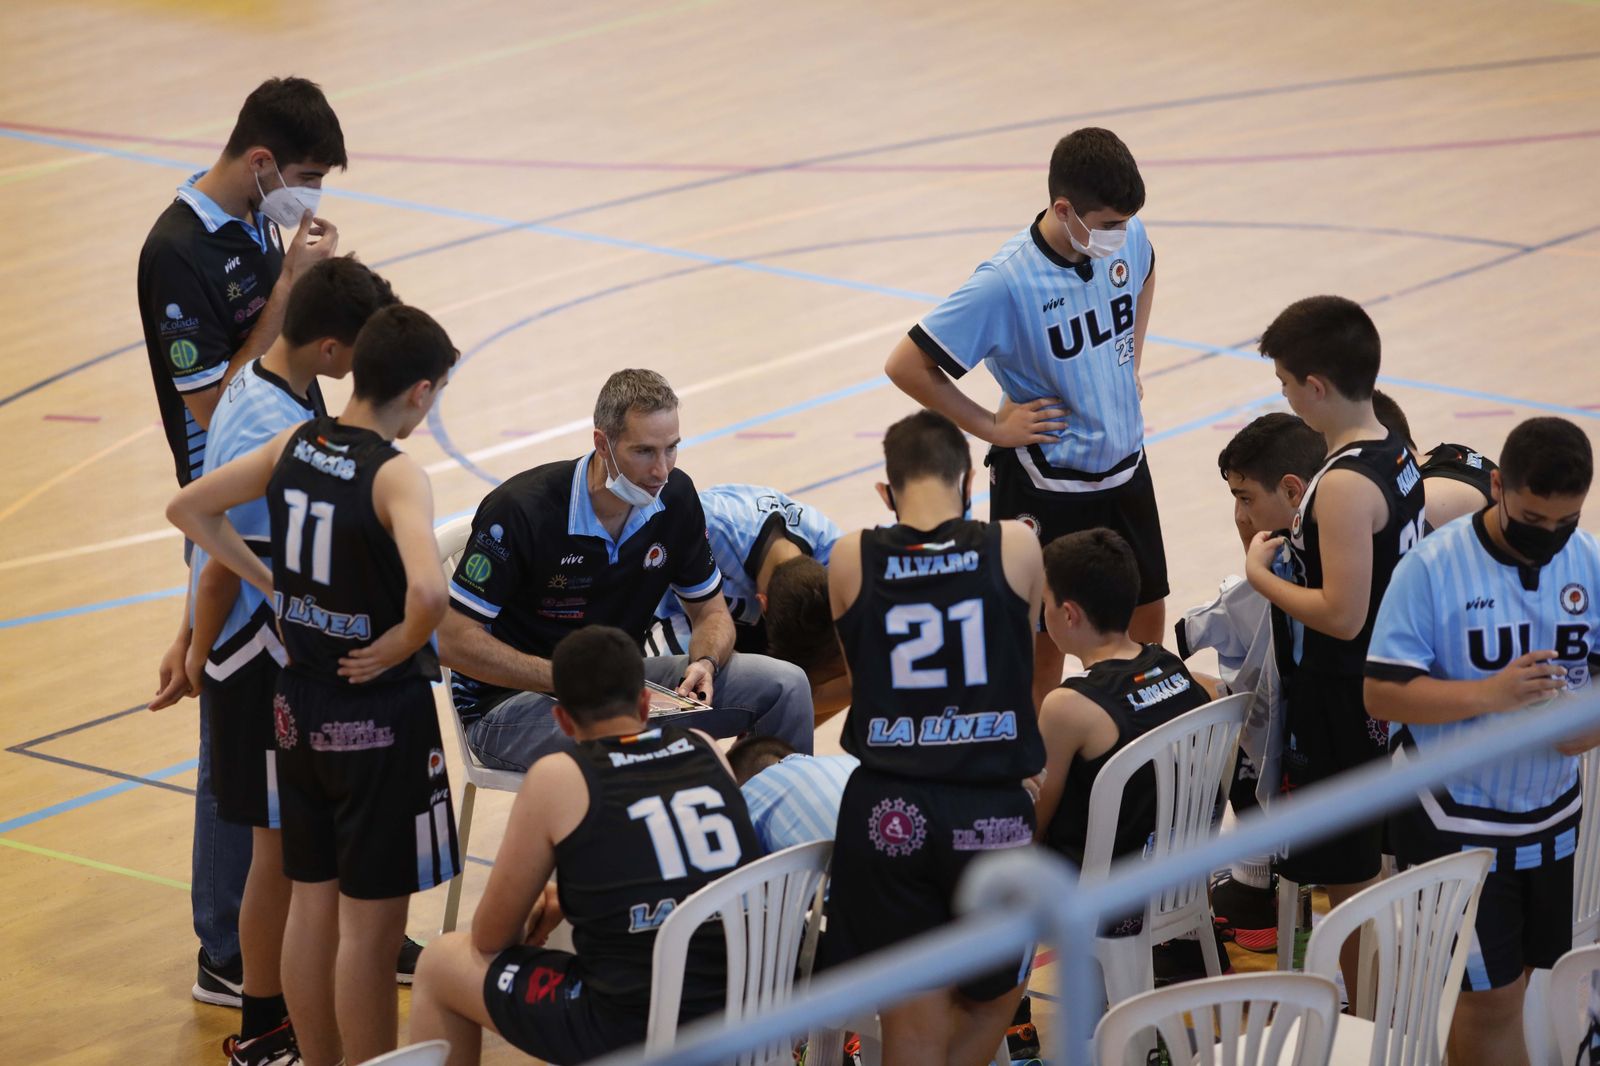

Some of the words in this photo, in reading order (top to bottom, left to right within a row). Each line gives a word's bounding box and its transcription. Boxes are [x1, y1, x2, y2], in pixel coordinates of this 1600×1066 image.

[224, 256, 241, 274] vive
[1043, 298, 1065, 313] vive
[1046, 292, 1135, 361] ULB
[283, 488, 335, 586] 11
[560, 554, 585, 565] vive
[285, 594, 372, 640] LÍNEA
[1465, 598, 1495, 611] vive
[885, 598, 988, 689] 21
[867, 717, 914, 747] LA
[918, 706, 1018, 745] LÍNEA
[626, 785, 742, 881] 16
